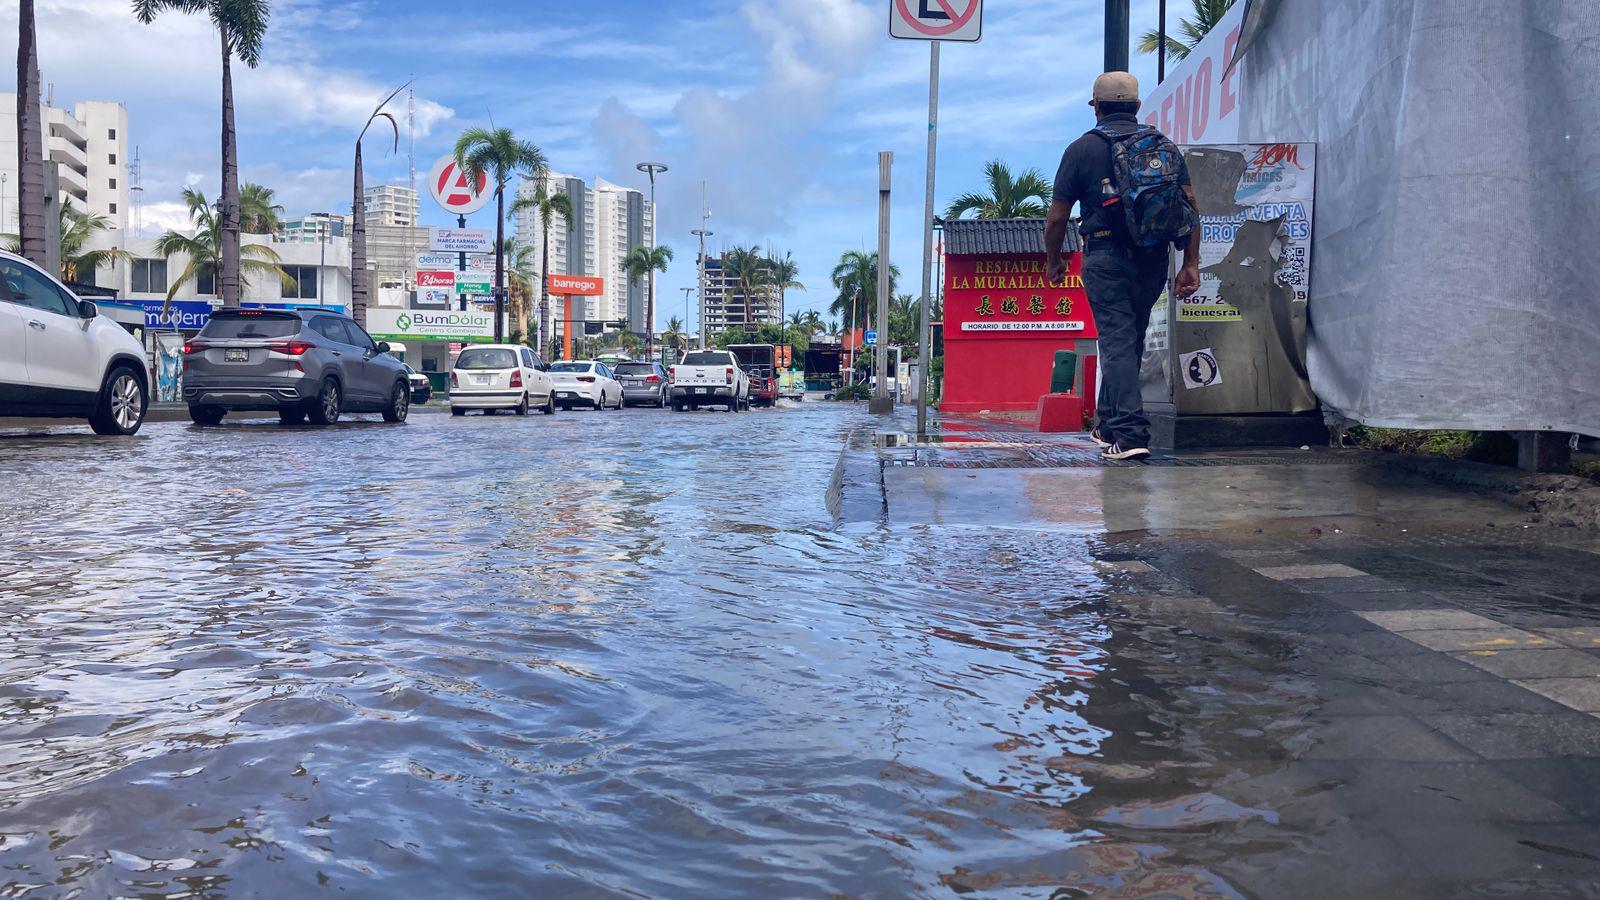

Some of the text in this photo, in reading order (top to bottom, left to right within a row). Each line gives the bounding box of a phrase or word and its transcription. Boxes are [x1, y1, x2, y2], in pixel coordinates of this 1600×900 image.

[1254, 203, 1304, 219] VENTA
[418, 255, 452, 264] derma
[975, 260, 1072, 274] RESTAURAT
[553, 277, 596, 291] banregio
[952, 276, 969, 289] LA
[974, 275, 1045, 289] MURALLA
[413, 313, 491, 326] BumDólar
